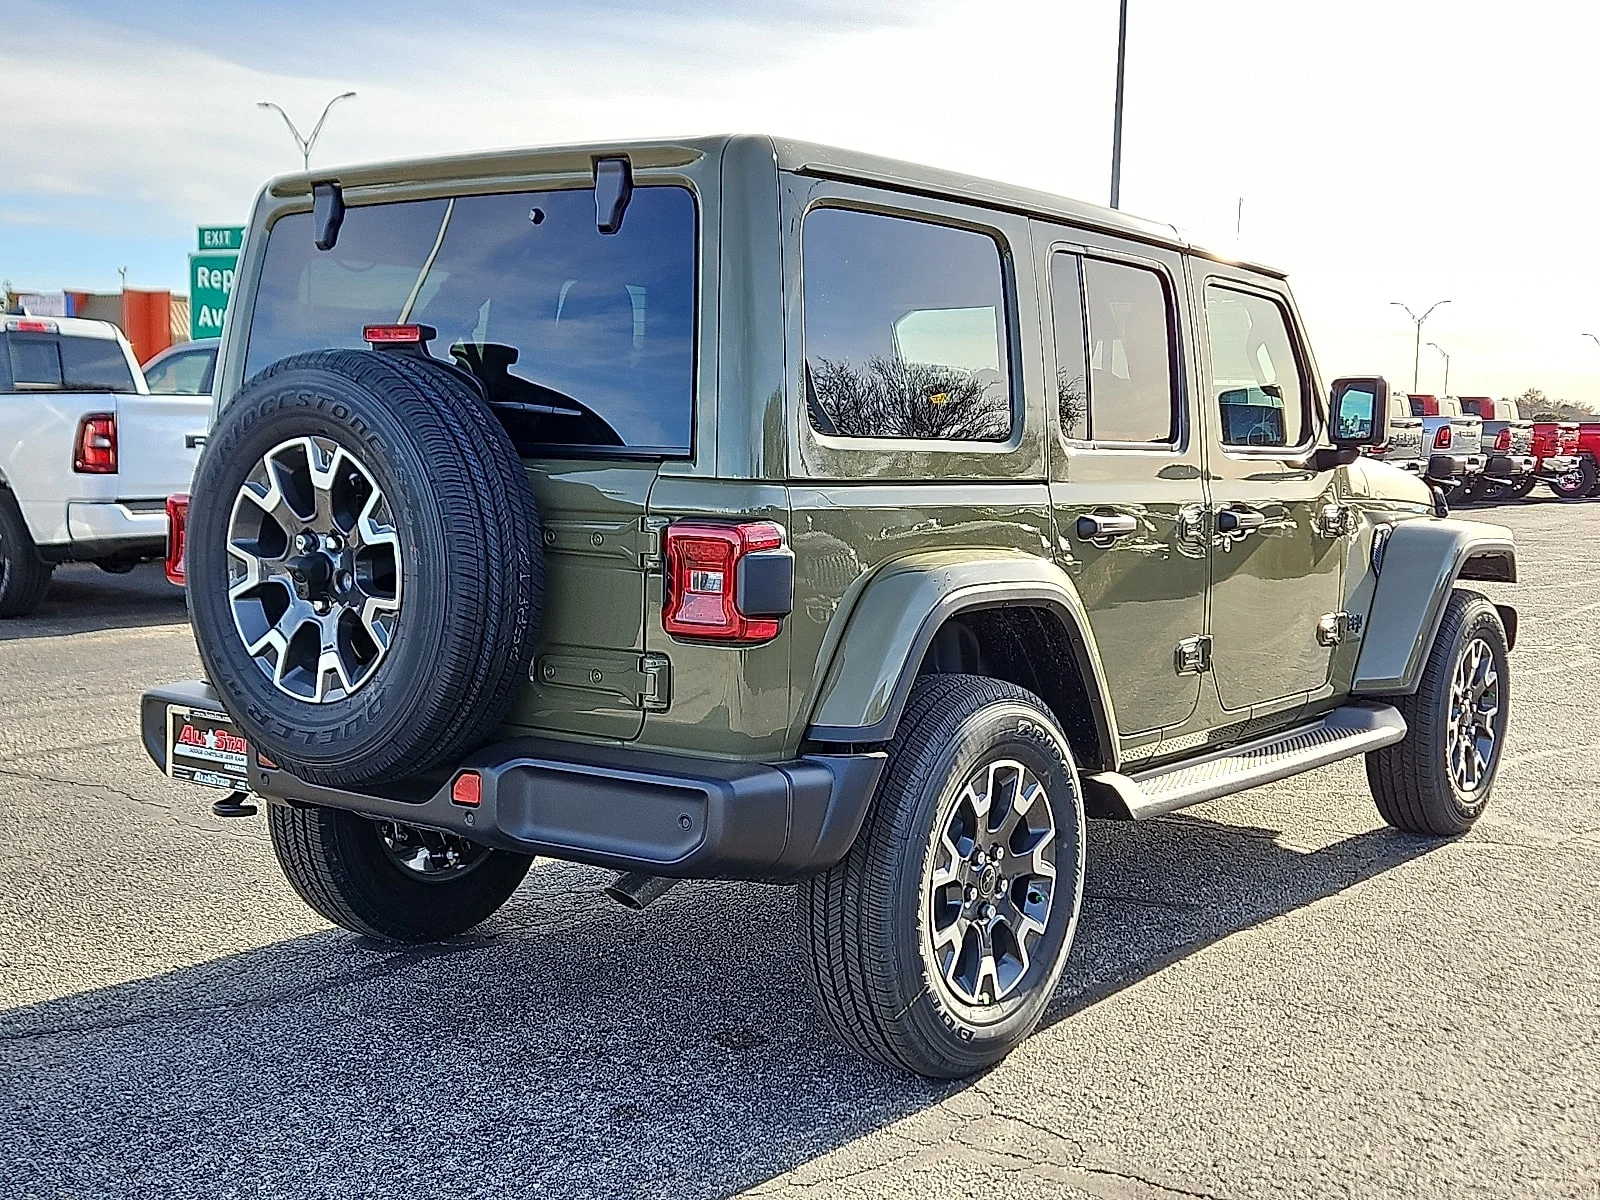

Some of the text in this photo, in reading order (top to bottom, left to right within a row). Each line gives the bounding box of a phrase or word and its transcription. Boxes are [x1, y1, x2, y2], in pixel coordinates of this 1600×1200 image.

[204, 230, 231, 246] EXIT
[198, 304, 226, 328] Av
[214, 729, 247, 754] STA
